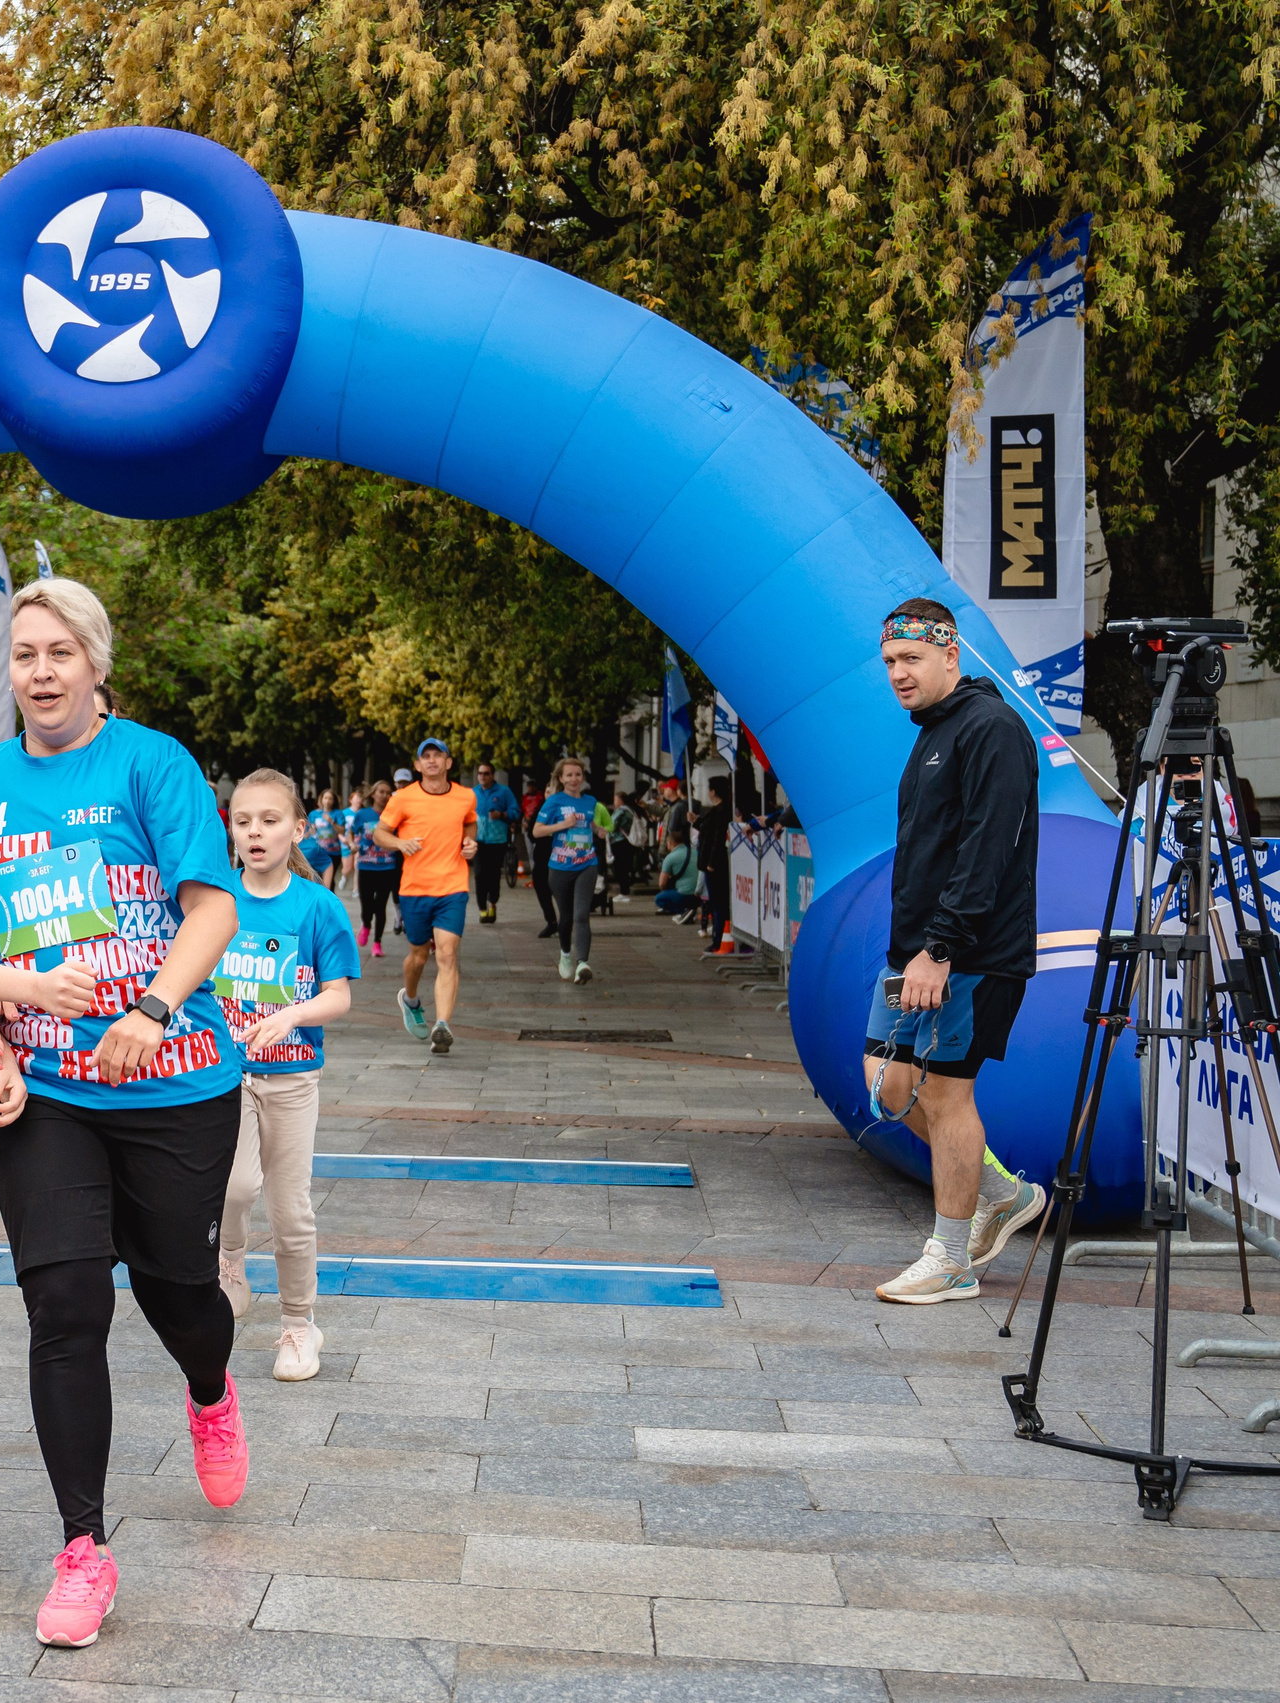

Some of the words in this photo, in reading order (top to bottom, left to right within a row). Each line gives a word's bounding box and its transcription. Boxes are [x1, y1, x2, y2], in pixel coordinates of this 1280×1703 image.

[89, 272, 151, 292] 1995
[65, 848, 77, 861] D
[0, 864, 15, 876] ПСБ
[10, 875, 85, 923] 10044
[222, 951, 275, 981] 10010
